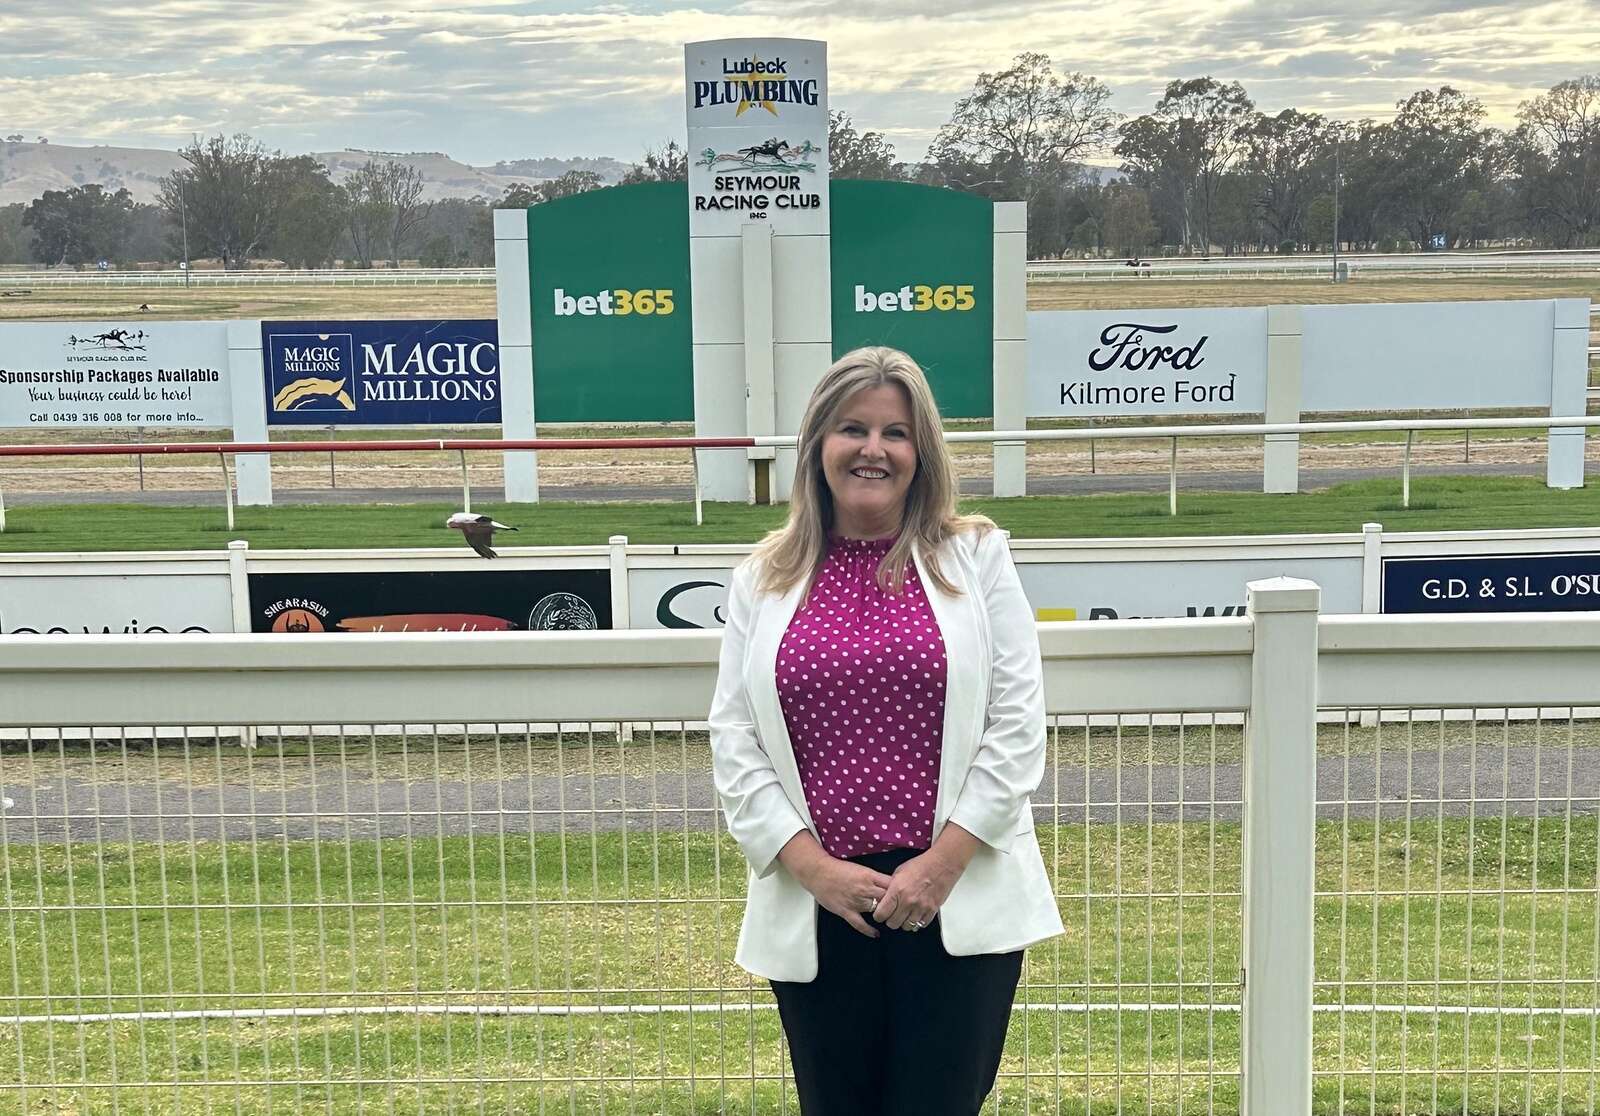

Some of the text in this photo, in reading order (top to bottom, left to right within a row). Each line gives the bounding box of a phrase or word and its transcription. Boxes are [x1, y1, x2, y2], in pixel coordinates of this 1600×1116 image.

[722, 57, 788, 75] Lubeck
[693, 79, 819, 109] PLUMBING
[714, 175, 801, 191] SEYMOUR
[695, 194, 821, 210] RACING CLUB
[554, 288, 675, 316] bet365
[855, 284, 976, 312] bet365
[284, 347, 340, 362] MAGIC
[1088, 323, 1209, 372] Ford
[285, 361, 340, 372] MILLIONS
[361, 342, 496, 376] MAGIC
[0, 368, 220, 384] Sponsorship Packages Available
[28, 385, 192, 402] Your business could be here!
[362, 379, 497, 401] MILLIONS
[1060, 377, 1235, 405] Kilmore Ford
[29, 413, 48, 422] Call
[53, 413, 78, 422] 0439
[82, 413, 99, 422] 316
[103, 413, 122, 422] 008
[127, 412, 141, 421] for
[146, 413, 172, 421] more
[1422, 578, 1470, 599] G.D.
[1479, 578, 1496, 598] &
[1505, 576, 1544, 597] S.L.
